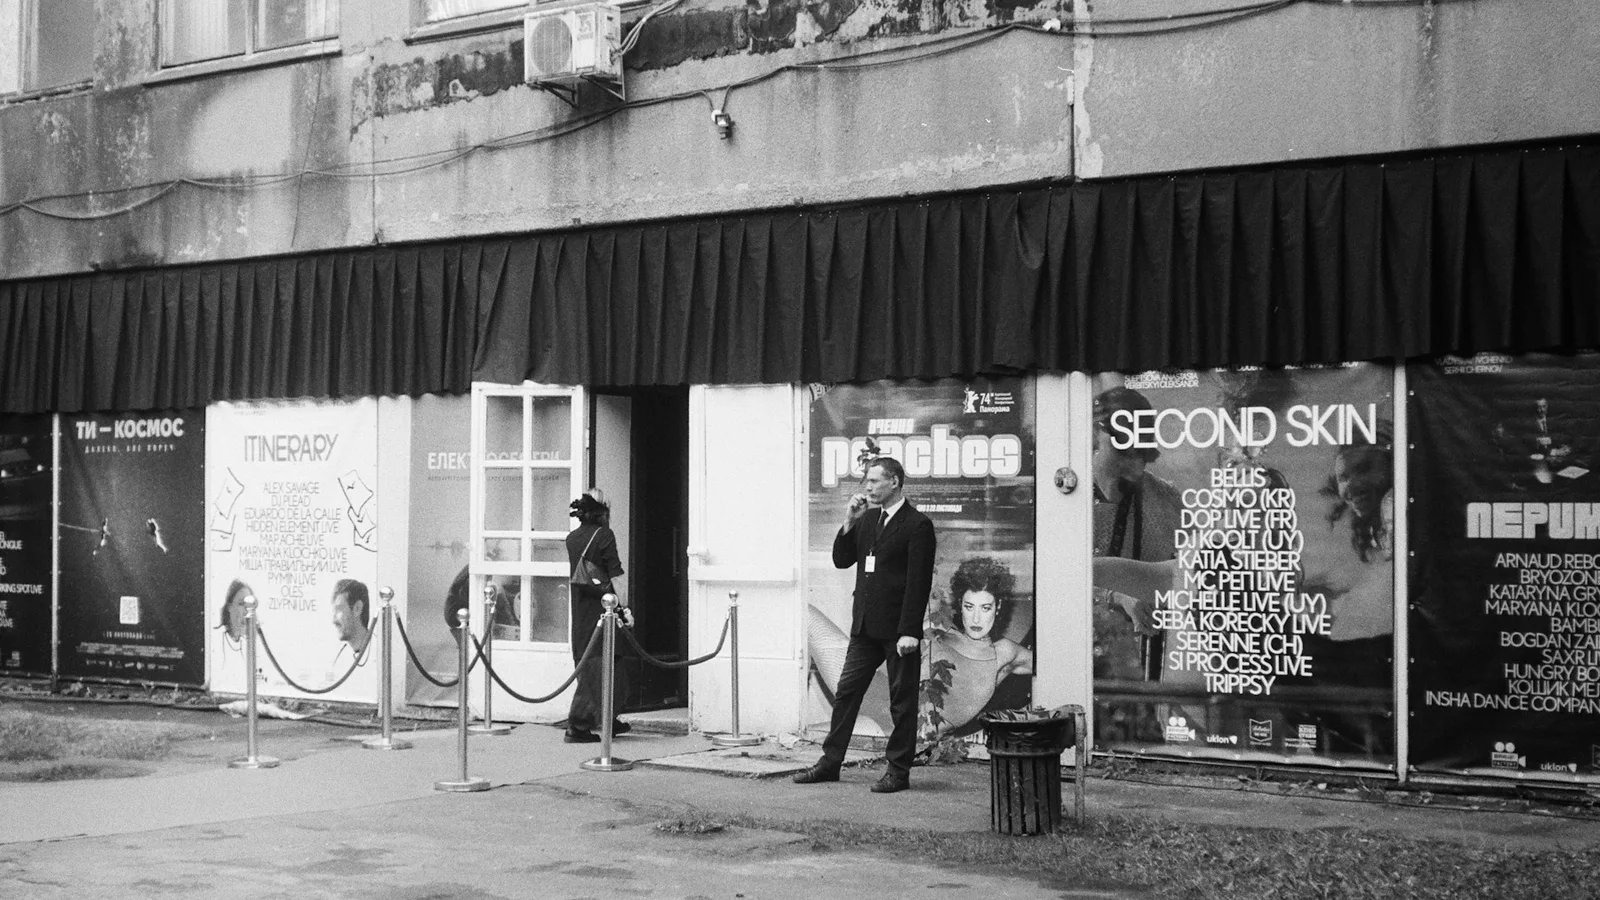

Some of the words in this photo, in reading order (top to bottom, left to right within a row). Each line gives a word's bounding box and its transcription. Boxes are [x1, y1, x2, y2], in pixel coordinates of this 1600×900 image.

[76, 420, 97, 439] ТИ
[114, 418, 184, 438] КОСМОС
[1110, 406, 1277, 450] SECOND
[1285, 403, 1377, 447] SKIN
[244, 433, 338, 462] ITINERARY
[821, 424, 1022, 487] peaches
[1211, 467, 1266, 488] BELLIS
[264, 482, 284, 494] ALEX
[285, 482, 320, 494] SAVAGE
[283, 495, 311, 508] PLEAD
[1182, 488, 1257, 509] COSMO
[1260, 488, 1296, 511] (KR)
[244, 507, 286, 520] EDUARDO
[287, 508, 299, 520] DE
[301, 508, 312, 520] LA
[313, 508, 341, 520] CALLE
[1181, 509, 1222, 529] DOP
[1225, 509, 1261, 529] LIVE
[1264, 509, 1298, 531] (FR)
[246, 520, 278, 533] HIDDEN
[279, 521, 320, 533] ELEMENT
[321, 521, 340, 534] LIVE
[307, 534, 325, 546] LIVE
[1175, 530, 1197, 549] DJ
[1200, 530, 1259, 550] KOOLT
[1263, 530, 1304, 552] (UY)
[283, 547, 328, 559] KLOCHKO
[329, 547, 348, 560] LIVE
[1178, 549, 1229, 570] KATIA
[1231, 550, 1301, 571] STIEBER
[1495, 553, 1562, 569] ARNAUD
[329, 560, 348, 573] LIVE
[298, 573, 316, 585] LIVE
[1257, 572, 1295, 592] LIVE
[1520, 569, 1600, 585] BRYOZON
[280, 585, 304, 598] OLES
[1490, 585, 1570, 601] KATARYNA
[299, 598, 317, 612] LIVE
[1155, 590, 1240, 612] MICHELLE
[1243, 592, 1281, 613] LIVE
[1284, 592, 1327, 615] (UY)
[1485, 600, 1563, 617] MARYANA
[1566, 601, 1600, 617] KLO
[1152, 611, 1197, 631] SEBA
[1200, 612, 1290, 633] KORECKY
[1292, 614, 1331, 635] LIVE
[1176, 632, 1260, 654] SERENNE
[1264, 633, 1303, 656] (CH)
[1501, 632, 1571, 648] BOGDAN
[1169, 651, 1183, 670] SI
[1186, 653, 1272, 674] PROCESS
[1275, 656, 1313, 676] LIVE
[1542, 650, 1584, 666] SAXR
[1587, 651, 1600, 667] LI
[1504, 663, 1574, 680] HUNGRY
[1203, 674, 1276, 695] TRIPPSY
[1508, 679, 1570, 697] КОШИК
[1426, 690, 1471, 708] INSHA
[1474, 693, 1528, 711] DANCE
[1207, 734, 1229, 744] uklon
[1541, 762, 1568, 771] uklon
